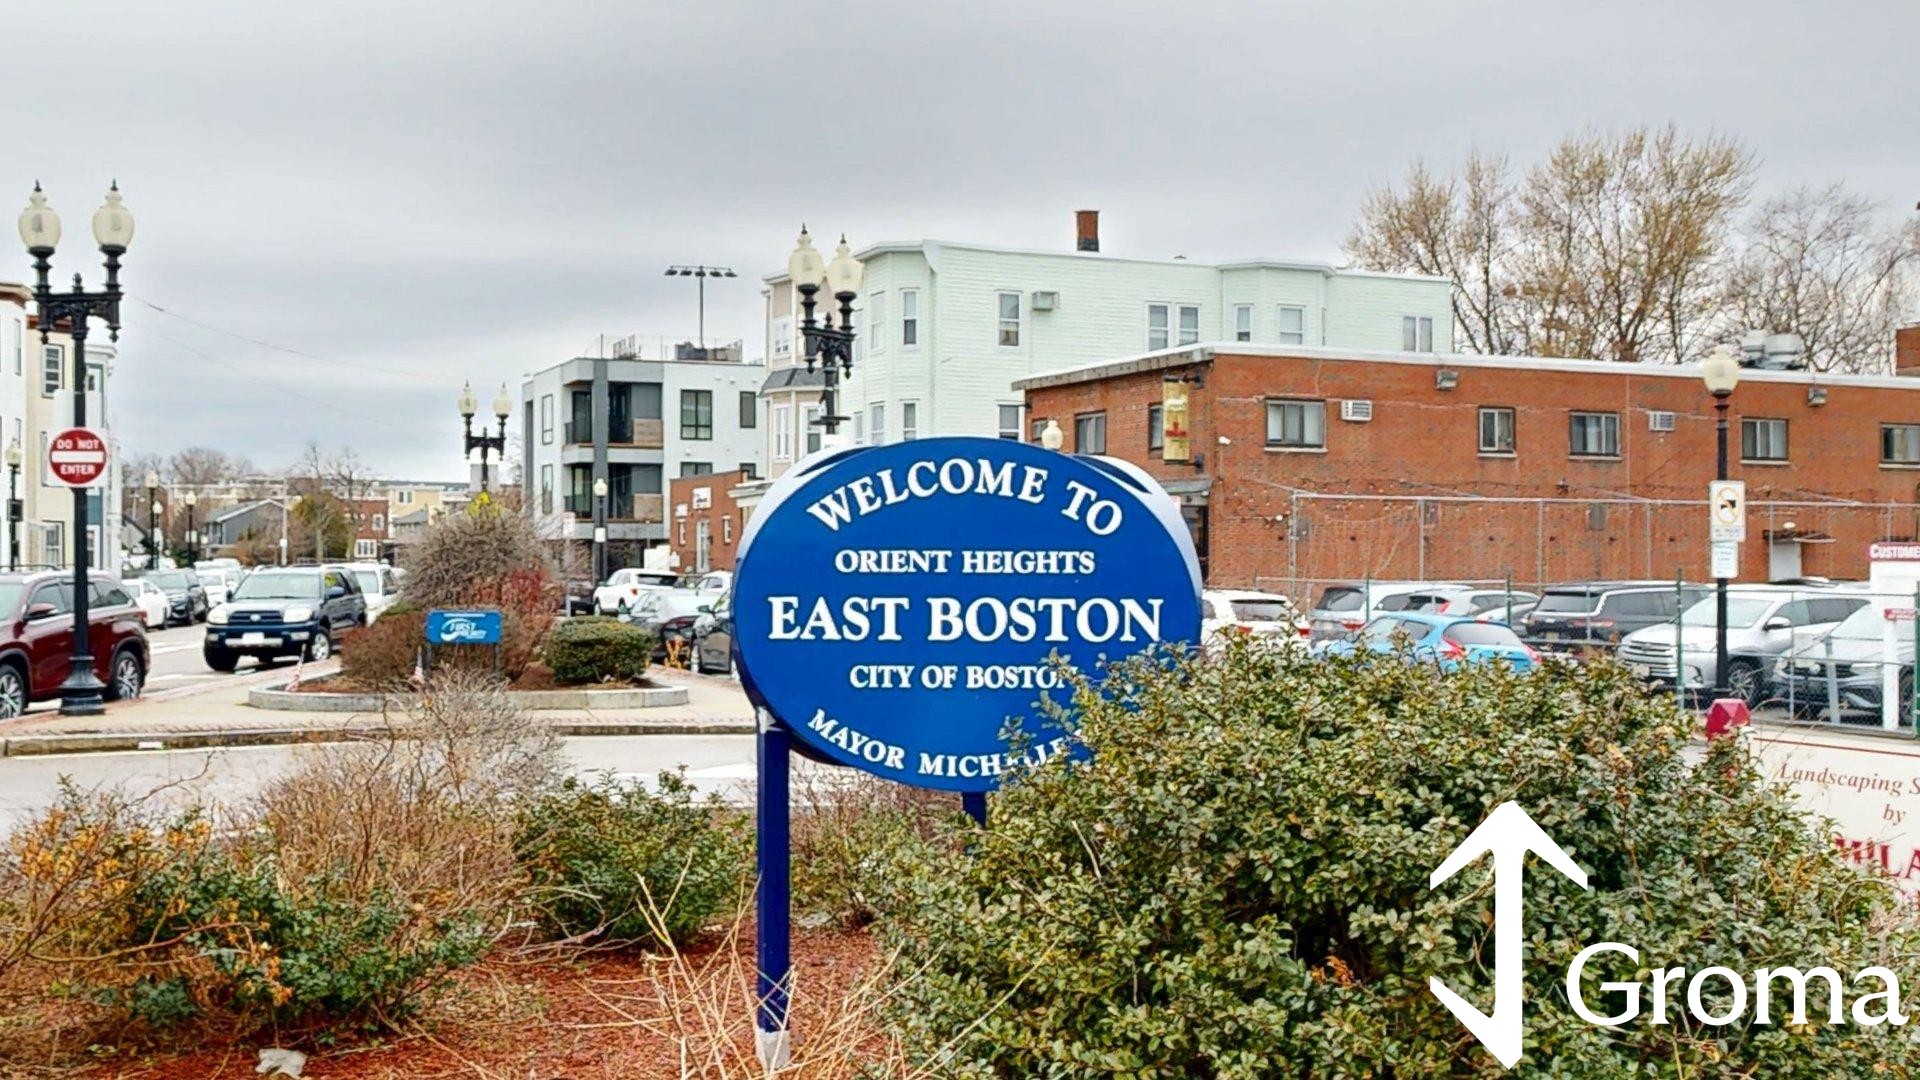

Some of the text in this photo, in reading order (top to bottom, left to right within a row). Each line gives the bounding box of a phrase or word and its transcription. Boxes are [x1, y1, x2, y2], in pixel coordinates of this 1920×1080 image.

[56, 439, 99, 450] DO NOT
[60, 464, 96, 475] ENTER
[806, 458, 1123, 535] WELCOME TO
[835, 549, 1095, 574] ORIENT HEIGHTS
[768, 596, 1164, 643] EAST BOSTON
[850, 665, 914, 689] CITY
[921, 665, 957, 689] OF
[808, 709, 1066, 777] MAYOR MICHLE
[1780, 762, 1904, 797] Landscaping
[1883, 803, 1906, 825] by
